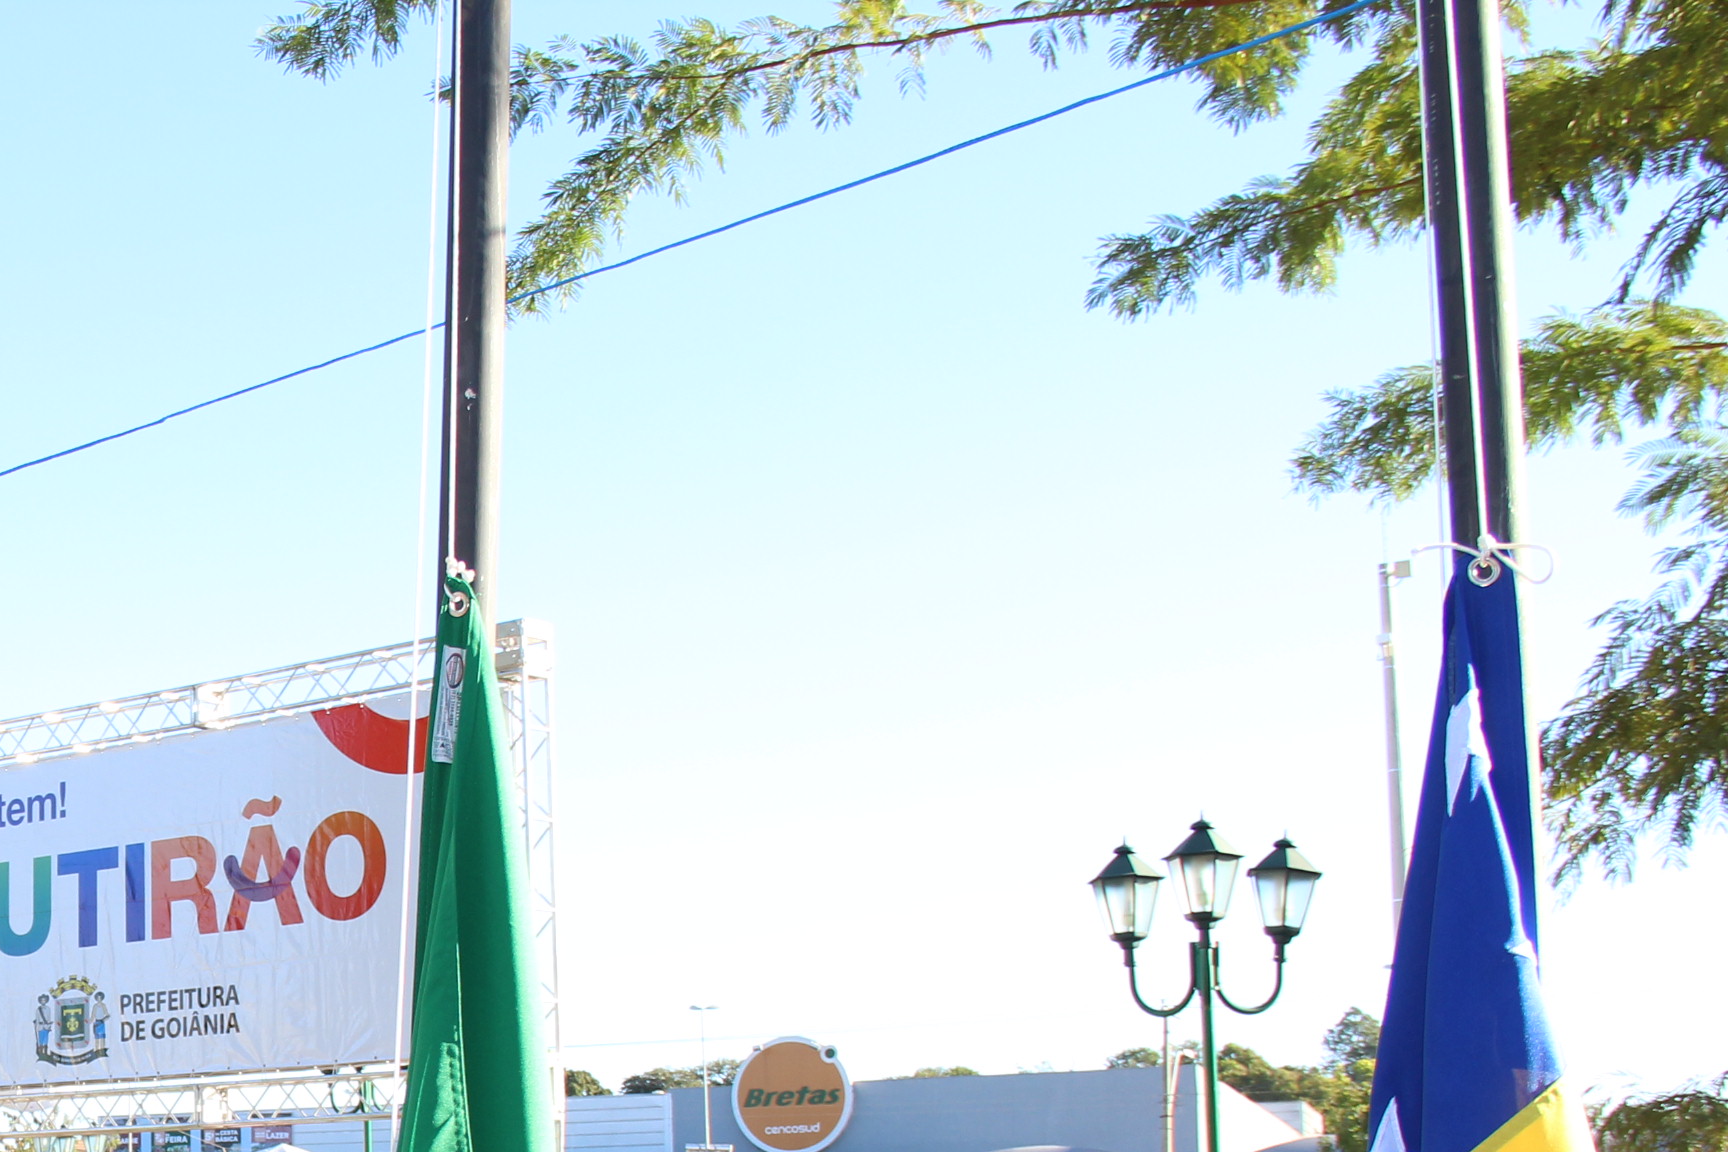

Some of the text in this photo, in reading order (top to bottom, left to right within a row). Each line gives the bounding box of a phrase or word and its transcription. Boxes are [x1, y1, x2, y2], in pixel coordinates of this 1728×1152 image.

[119, 984, 240, 1015] PREFEITURA
[120, 1011, 240, 1042] DE GOIÂNIA
[743, 1086, 841, 1108] Bretas
[265, 1131, 290, 1140] LAZER
[764, 1122, 820, 1135] cencosud
[165, 1135, 189, 1144] FEIRA
